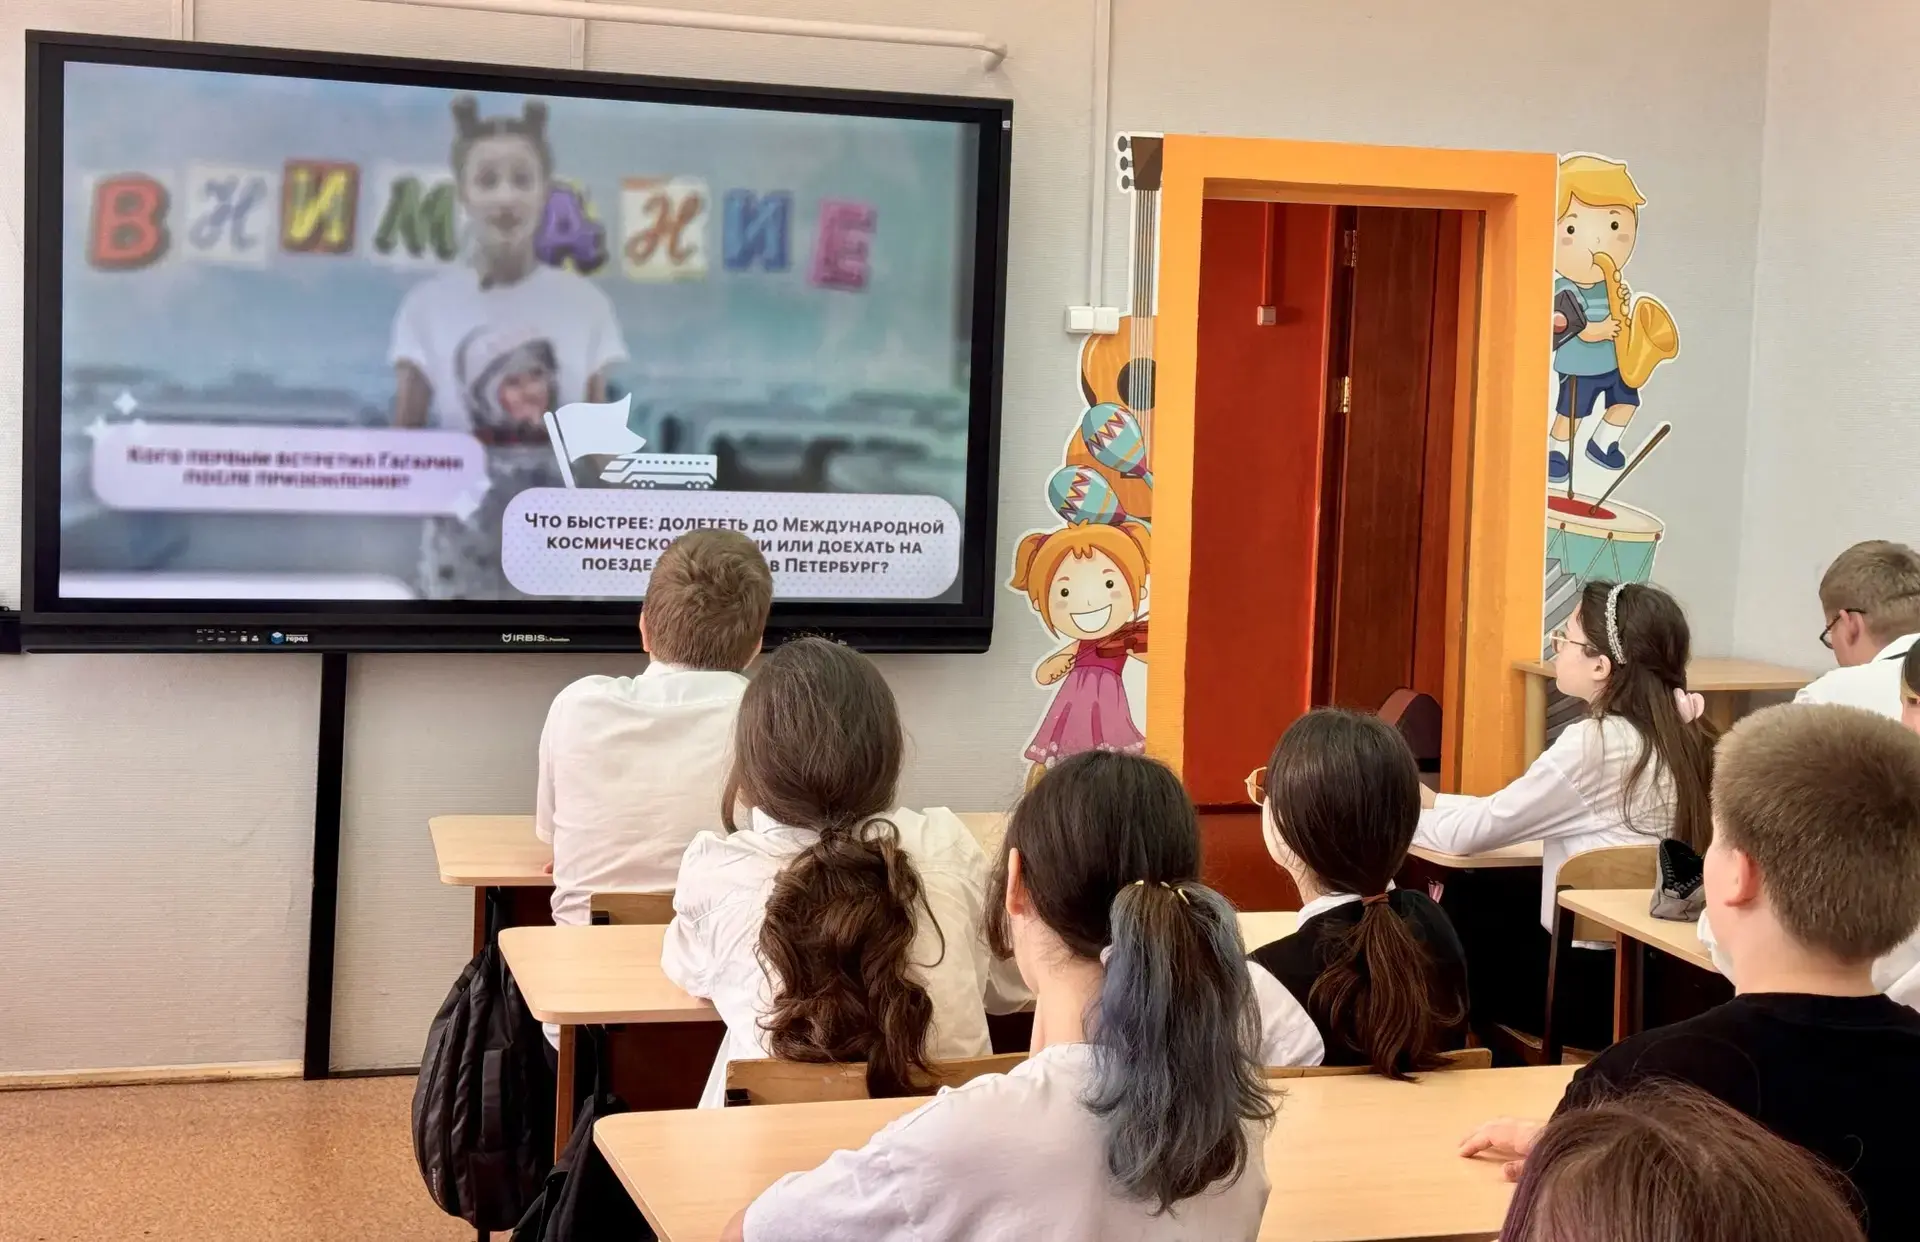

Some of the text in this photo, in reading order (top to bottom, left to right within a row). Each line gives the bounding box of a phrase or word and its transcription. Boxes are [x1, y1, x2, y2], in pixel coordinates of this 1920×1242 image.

[84, 161, 876, 291] ВНИМАНИЕ
[525, 513, 562, 529] ЧТО
[567, 515, 655, 530] БЫСТРЕЕ:
[753, 518, 778, 533] ДО
[783, 516, 944, 535] МЕЖДУНАРОДНОЙ
[547, 536, 678, 550] КОСМИЧЕСКО
[777, 539, 813, 553] ИЛИ
[817, 540, 895, 555] ДОЕХАТЬ
[899, 542, 922, 554] НА
[582, 558, 652, 572] ПОЕЗДЕ
[785, 558, 889, 573] ПЕТЕРБУРГ?
[512, 634, 545, 642] IRBIS
